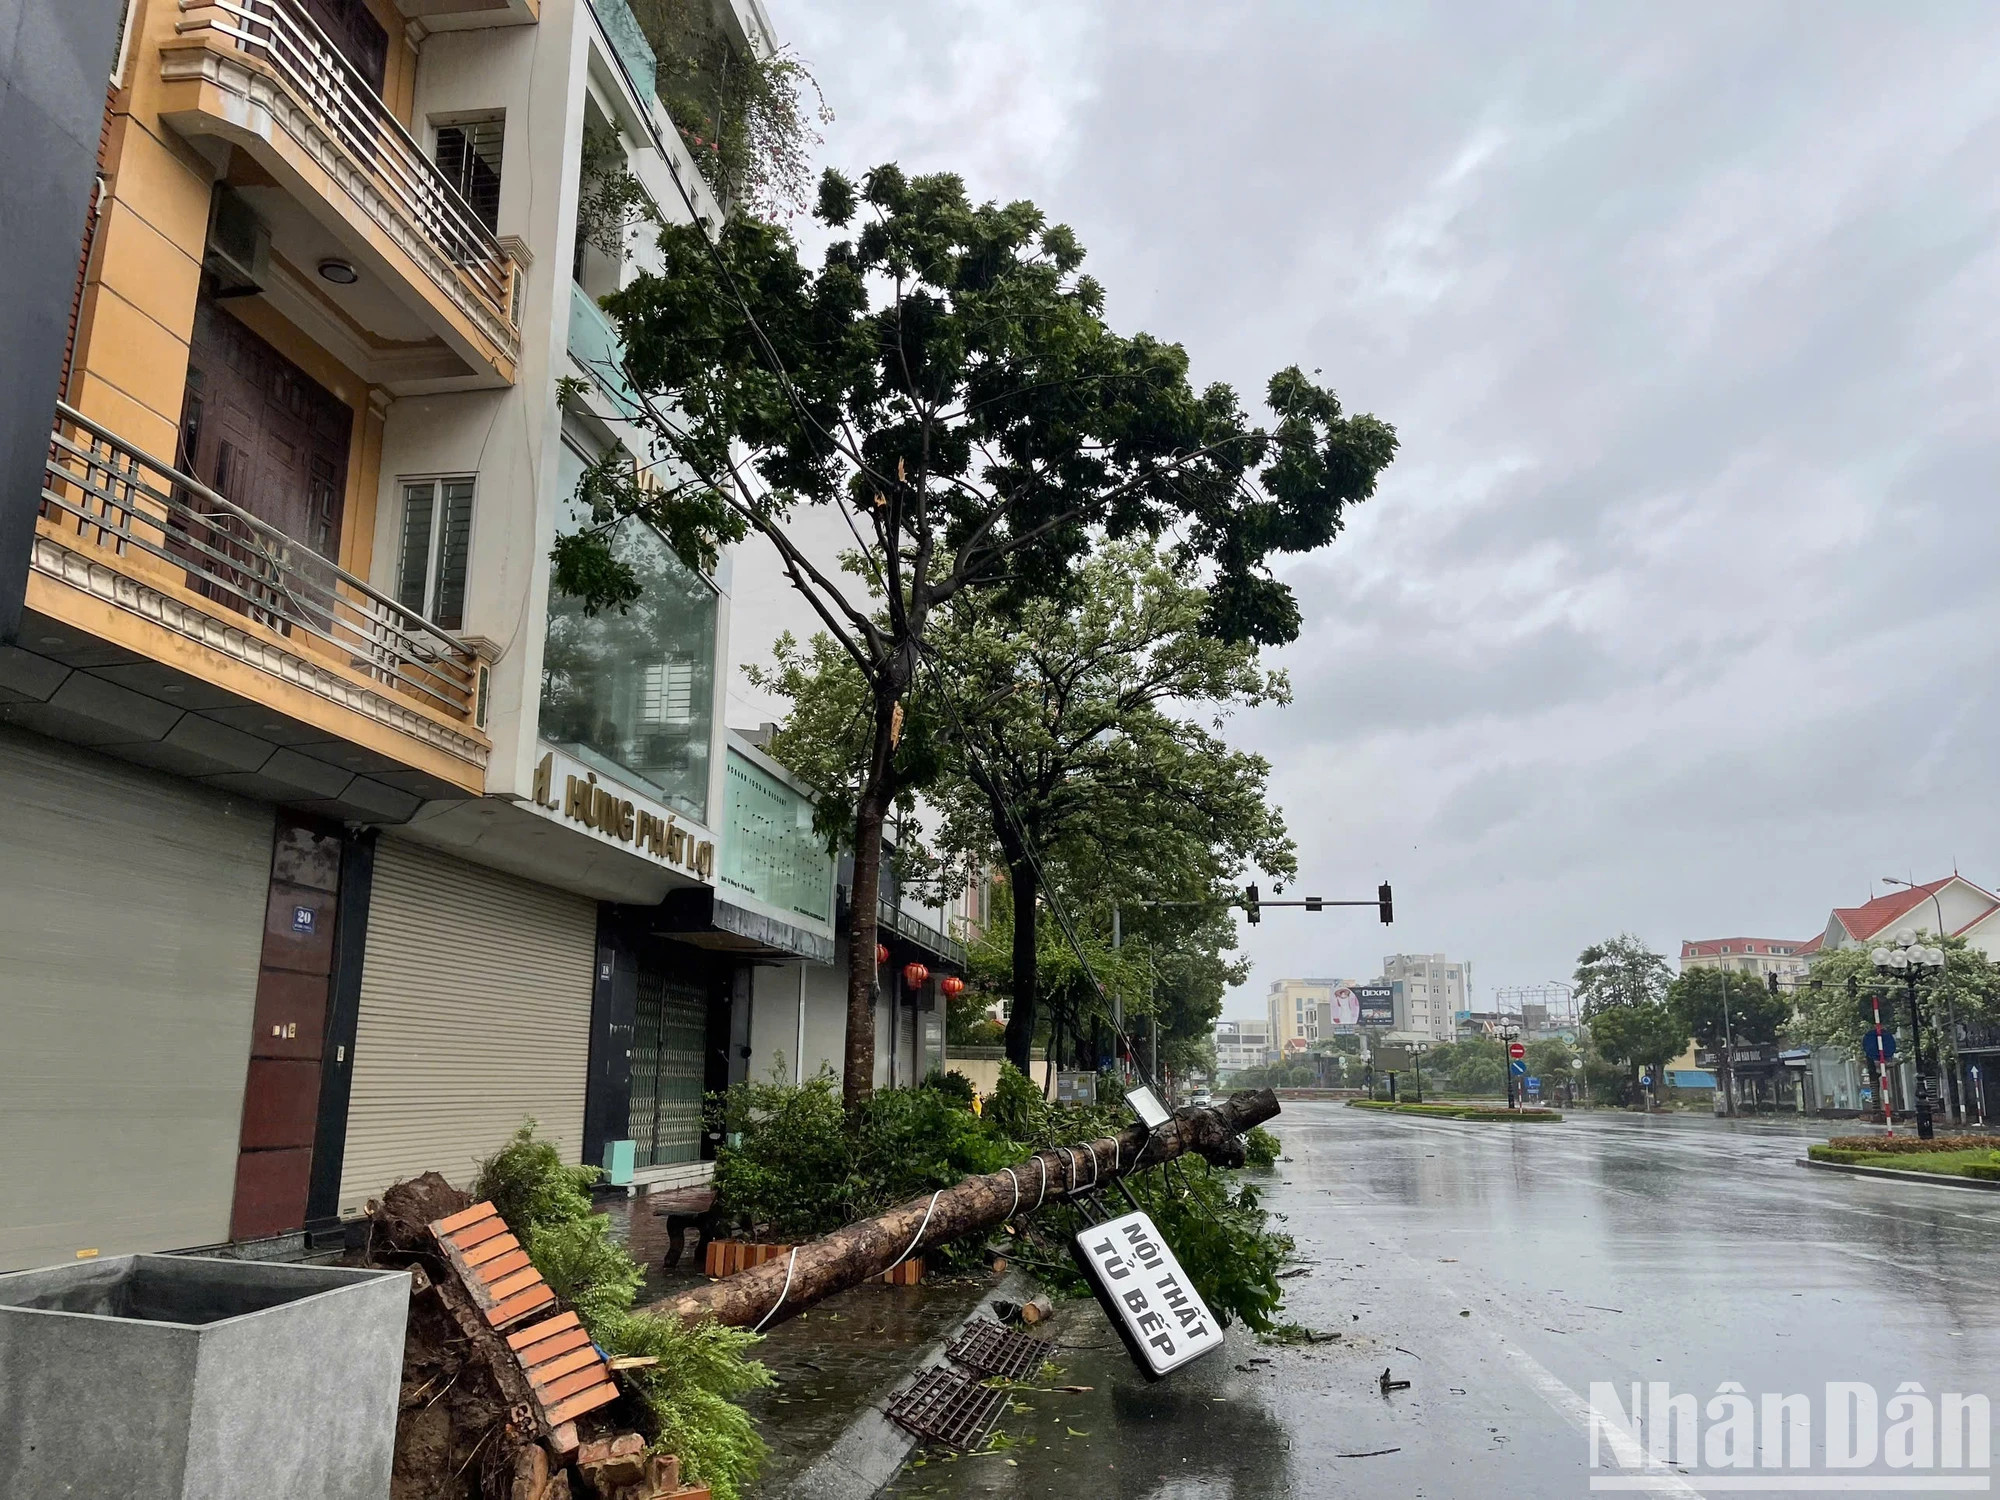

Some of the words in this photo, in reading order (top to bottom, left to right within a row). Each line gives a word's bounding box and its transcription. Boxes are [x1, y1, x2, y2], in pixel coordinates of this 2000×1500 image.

[565, 771, 635, 842] HÙNG
[635, 815, 688, 865] PHÁT
[686, 834, 715, 882] LỢI
[297, 910, 312, 924] 20
[1093, 1237, 1135, 1281] TỦ
[1122, 1288, 1177, 1357] BẾP
[1121, 1222, 1165, 1271] NỘI
[1155, 1272, 1209, 1340] THẤT
